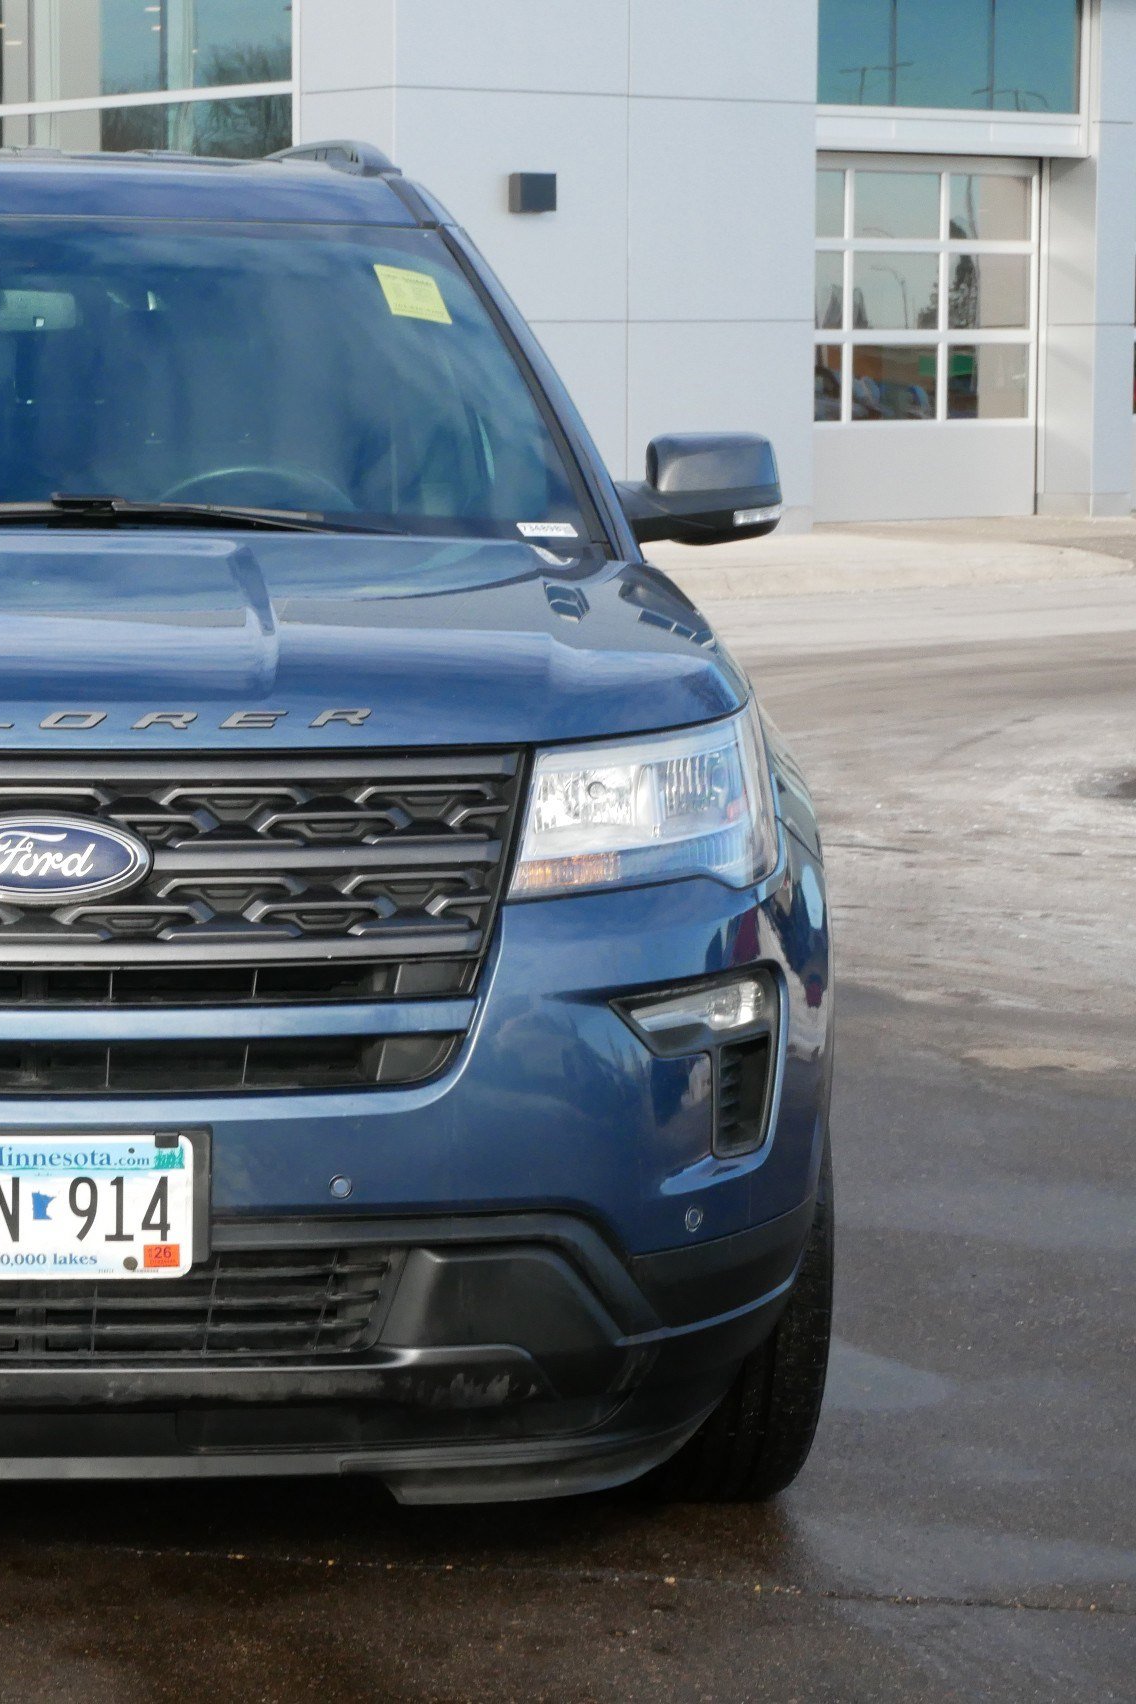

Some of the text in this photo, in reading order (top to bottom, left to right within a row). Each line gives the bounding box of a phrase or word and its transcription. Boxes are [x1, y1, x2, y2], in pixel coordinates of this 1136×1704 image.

[68, 1176, 170, 1242] 914
[52, 1252, 98, 1266] lakes
[154, 1246, 172, 1259] 26
